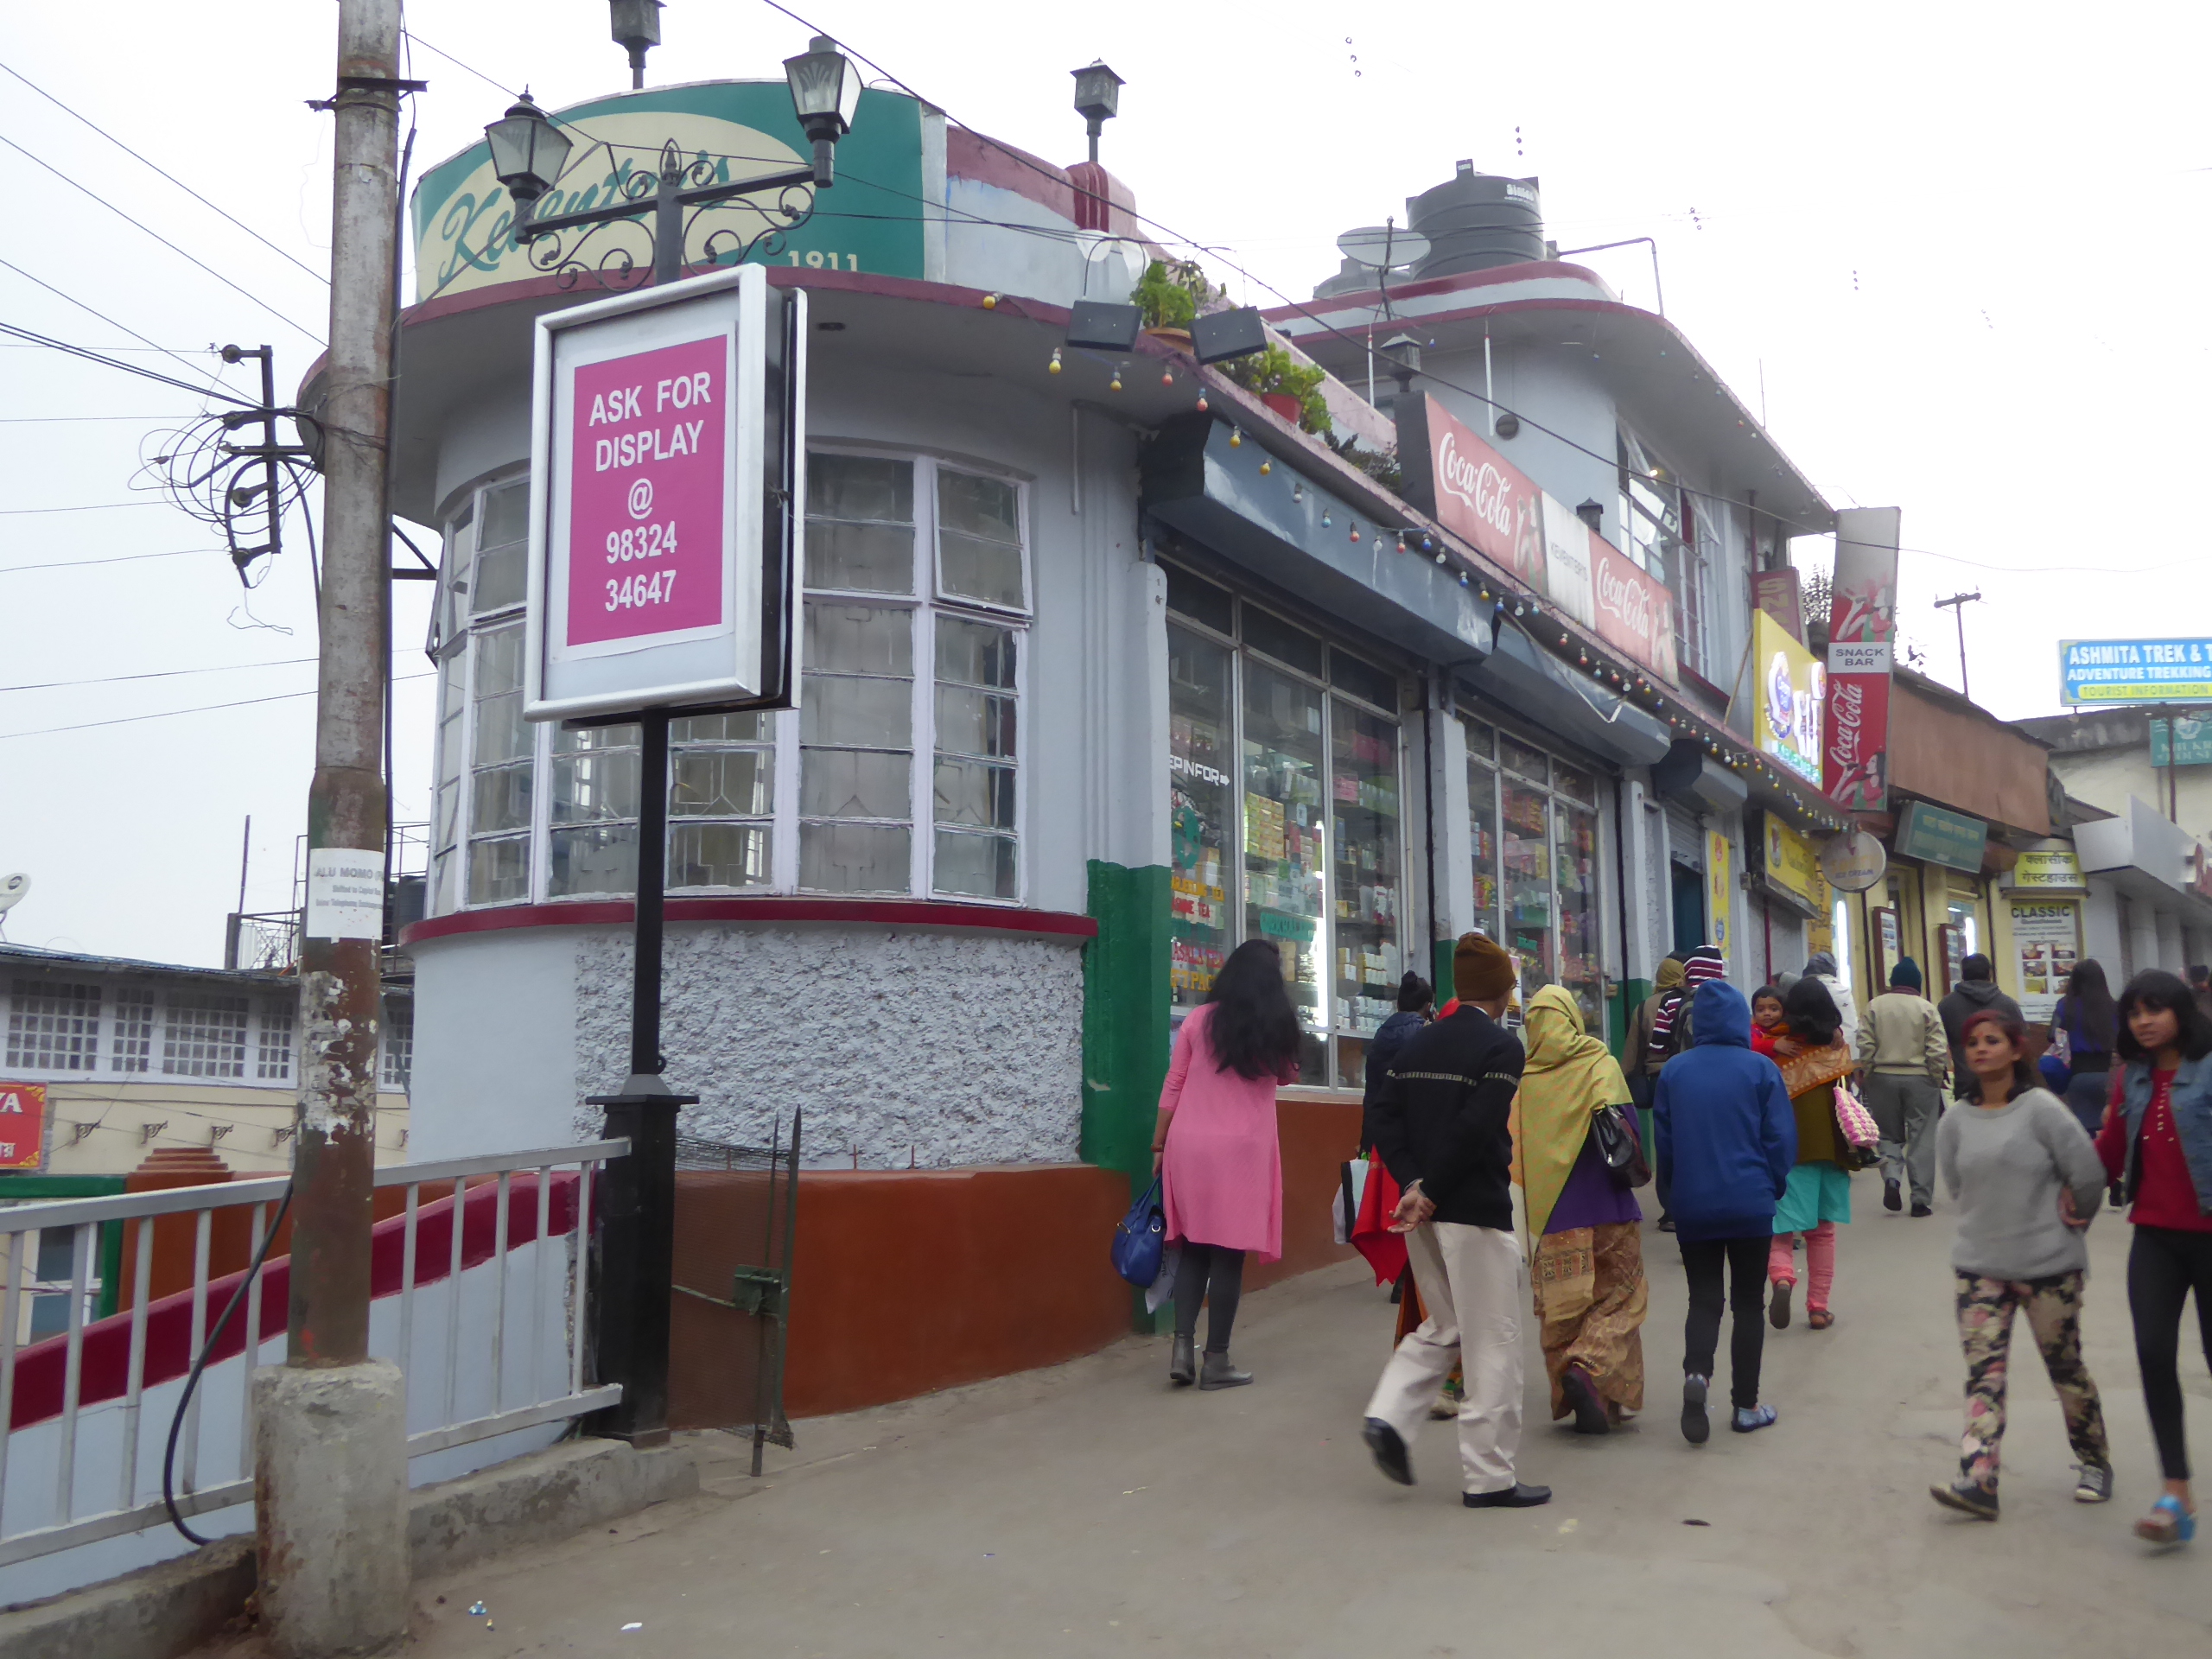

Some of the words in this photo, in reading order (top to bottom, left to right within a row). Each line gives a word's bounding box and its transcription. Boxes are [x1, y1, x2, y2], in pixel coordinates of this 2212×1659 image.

[788, 250, 858, 272] 1911
[589, 385, 642, 426] ASK
[657, 372, 711, 413] FOR
[595, 420, 704, 472] DISPLAY
[627, 478, 653, 520] @
[606, 520, 677, 564] 98324
[605, 569, 677, 612] 34647
[1835, 648, 1885, 658] SNACK
[1845, 657, 1874, 667] BAR
[2069, 645, 2141, 665] ASHMITA
[2142, 645, 2187, 664] TREK
[2190, 644, 2202, 663] &
[2067, 668, 2145, 681] ADVENTURE
[2145, 665, 2212, 680] TREKKING
[2083, 686, 2127, 696] TOURIST
[2132, 683, 2209, 696] INFORMATION
[315, 867, 336, 877] ALU
[340, 868, 372, 880] MOMO
[2011, 906, 2070, 918] CLASSIC
